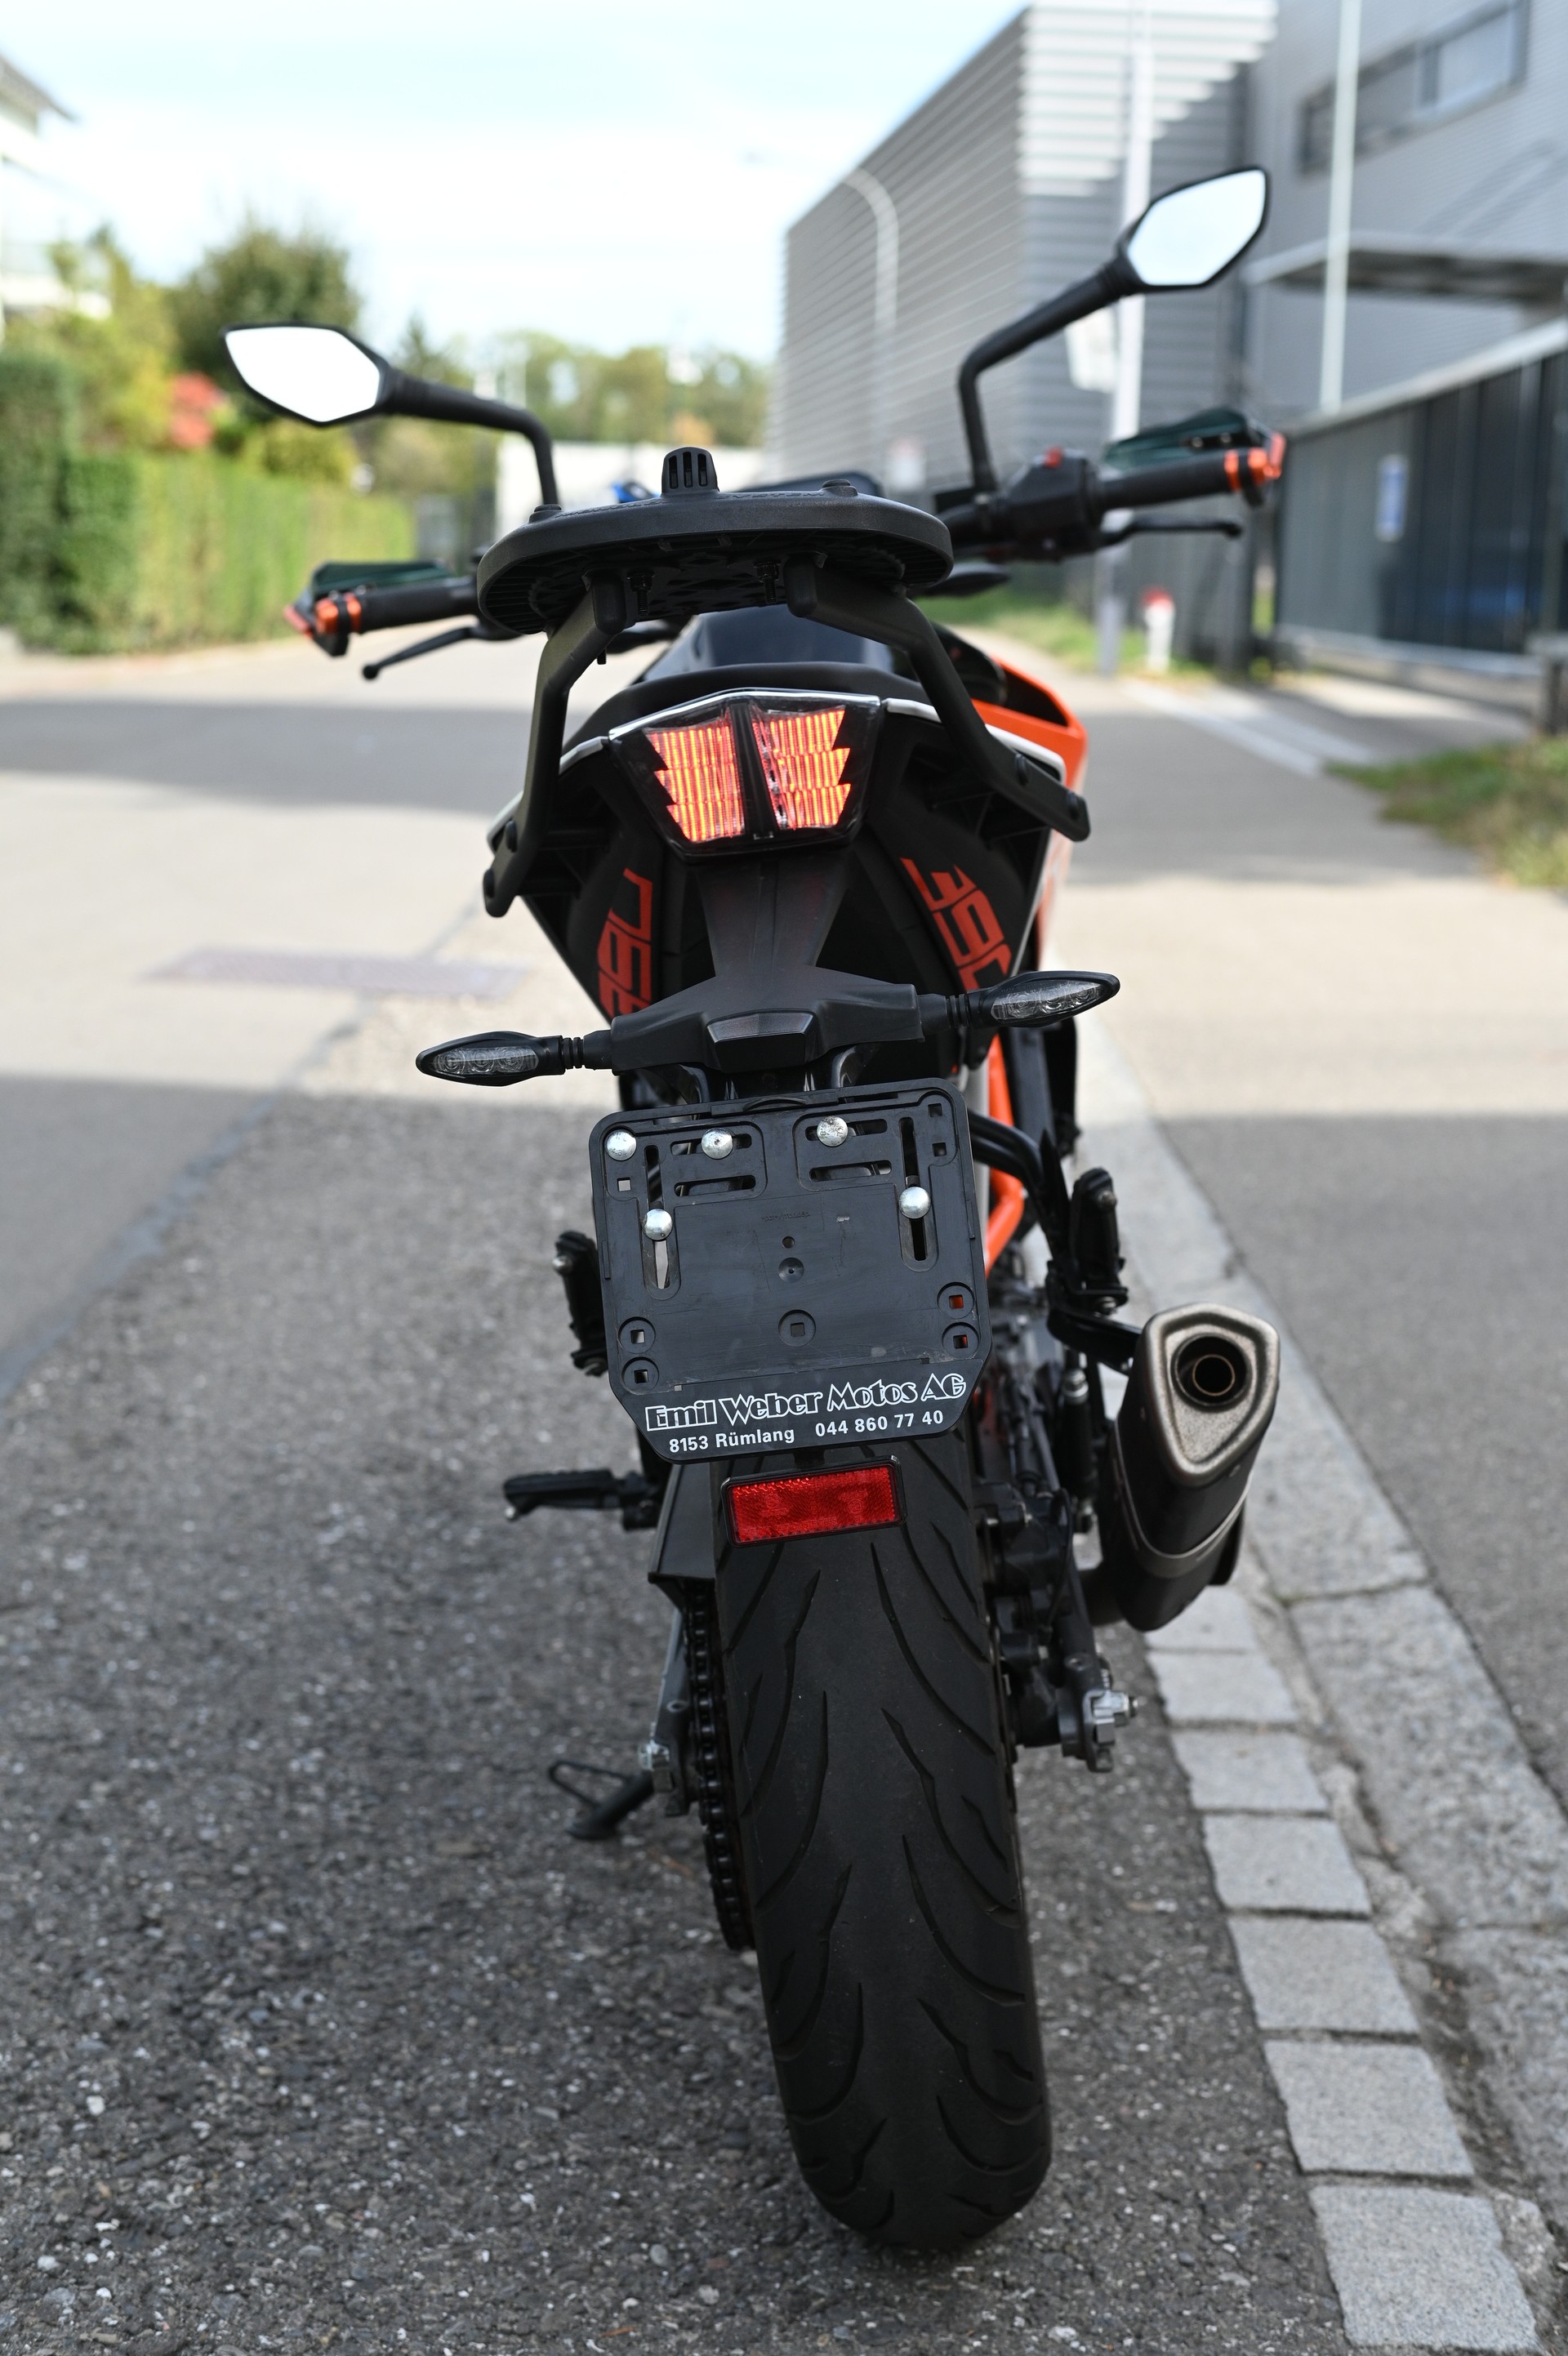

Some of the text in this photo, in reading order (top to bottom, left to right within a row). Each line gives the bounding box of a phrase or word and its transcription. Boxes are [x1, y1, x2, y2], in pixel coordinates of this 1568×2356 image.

[644, 1372, 967, 1432] Emil Weber Motos AG
[669, 1410, 944, 1454] 8153 Rümlang 044 860 77 40
